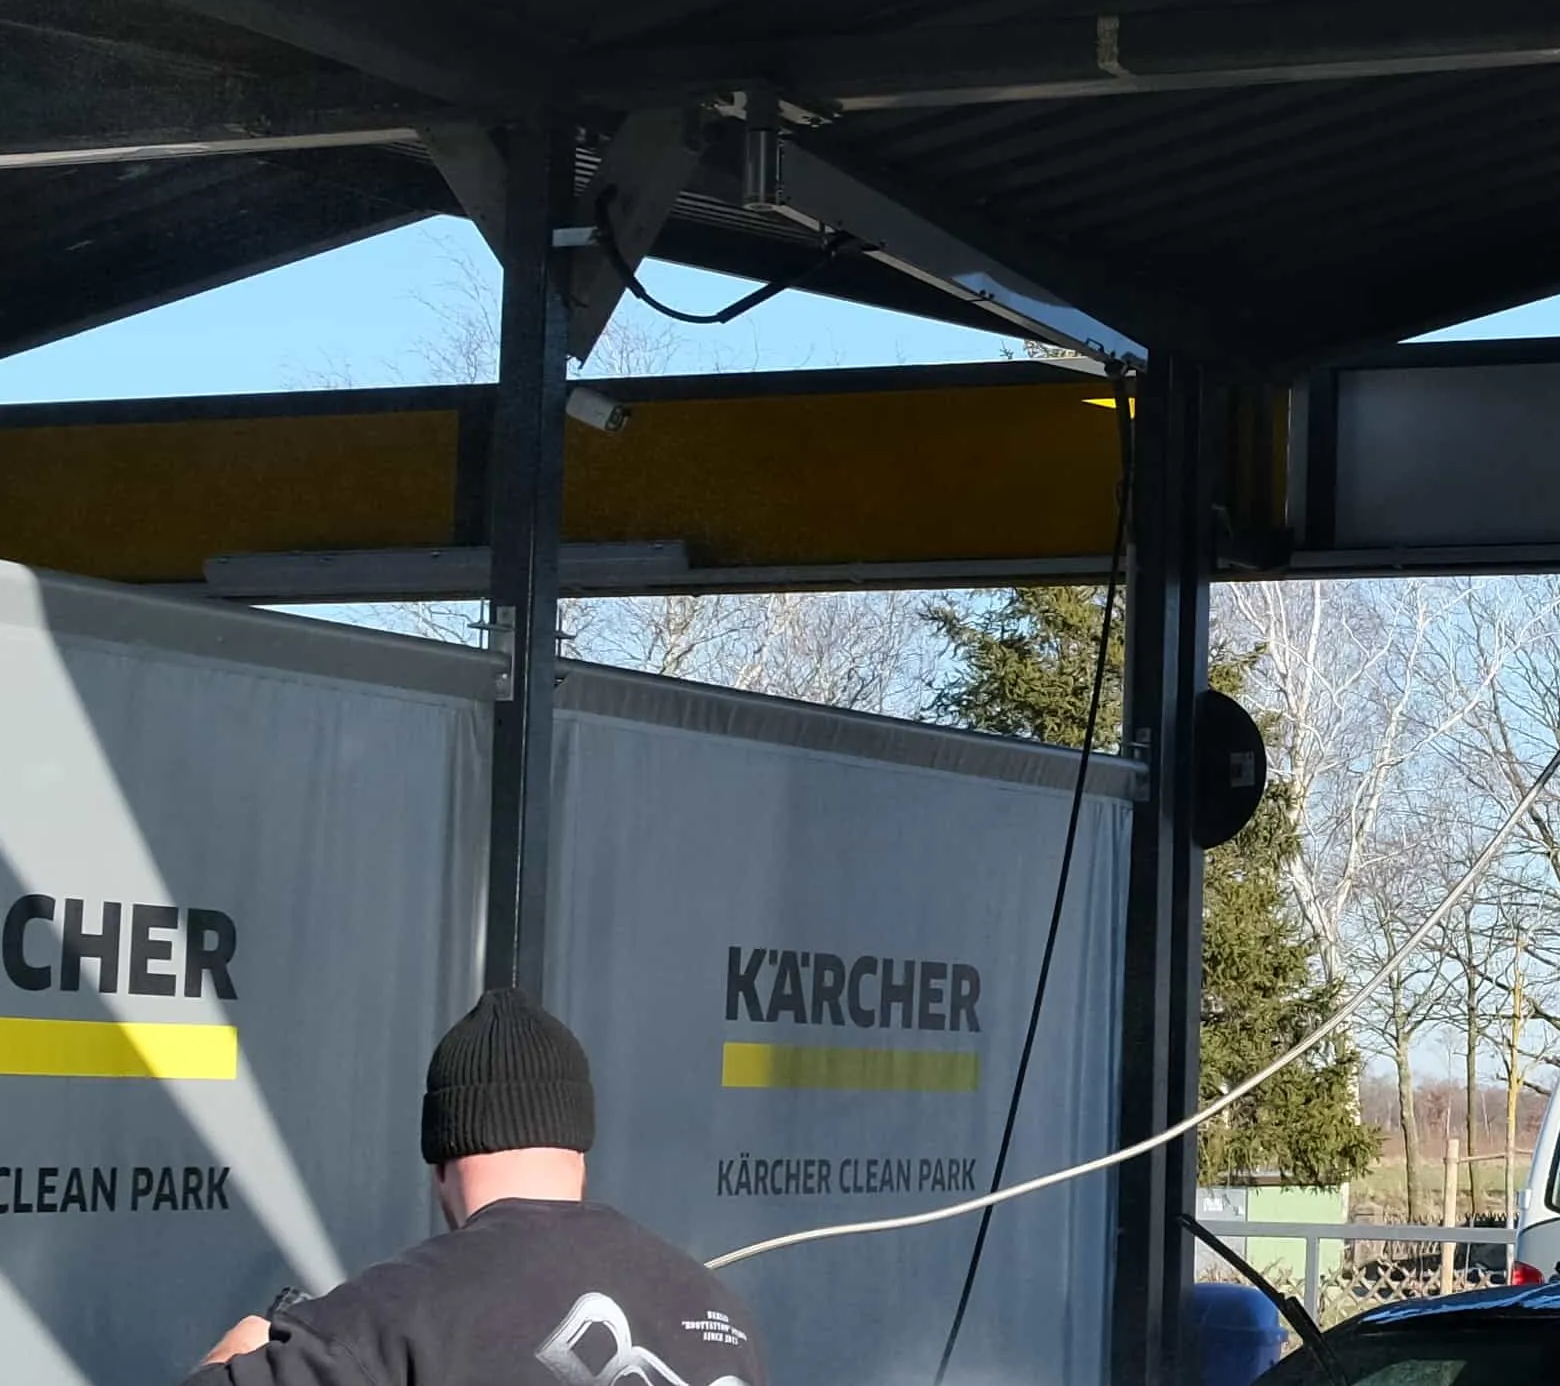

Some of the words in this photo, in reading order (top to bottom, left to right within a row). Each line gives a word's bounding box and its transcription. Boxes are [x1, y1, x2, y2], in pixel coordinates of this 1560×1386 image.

[724, 945, 982, 1033] KÄRCHER
[130, 1166, 232, 1212] PARK
[716, 1152, 832, 1197] KÄRCHER
[839, 1158, 912, 1194] CLEAN
[918, 1158, 977, 1192] PARK
